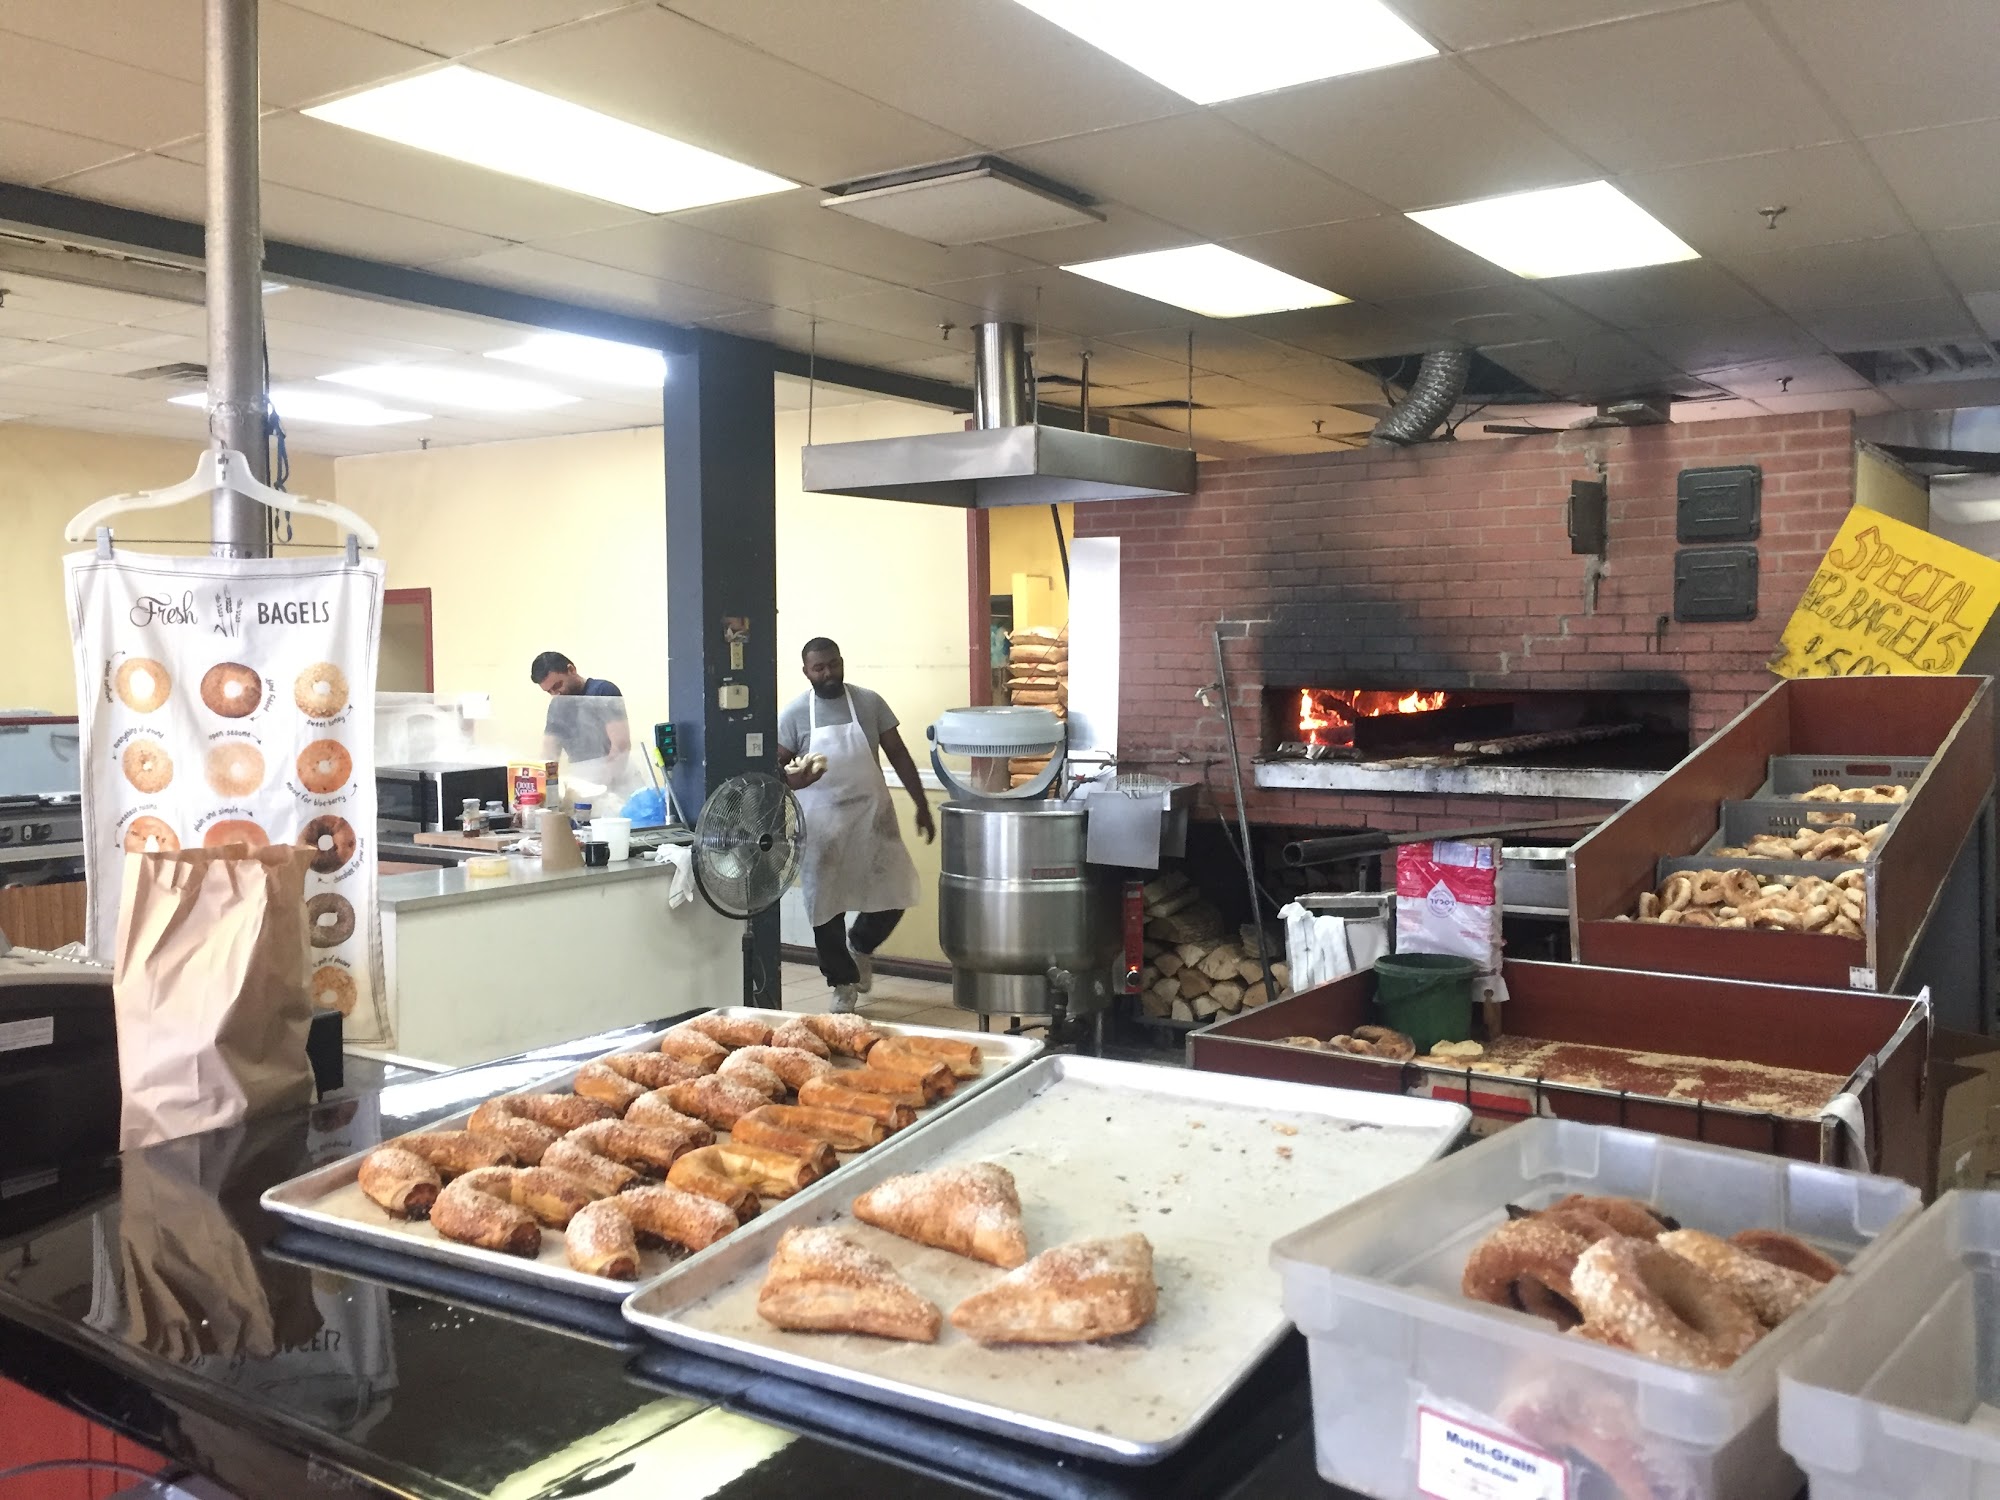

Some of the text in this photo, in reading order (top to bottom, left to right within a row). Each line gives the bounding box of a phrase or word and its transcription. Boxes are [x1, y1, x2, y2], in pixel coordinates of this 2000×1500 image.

[1829, 525, 1975, 632] SPECIAL
[129, 590, 330, 627] Fresh BAGELS
[1830, 587, 1966, 674] BAGELS
[306, 719, 326, 728] sweet
[208, 730, 251, 741] open sesame
[286, 781, 301, 798] mood
[301, 793, 311, 804] for
[219, 805, 239, 816] simple
[1430, 898, 1455, 907] LOCAL
[1446, 1430, 1537, 1475] Multi-Grain
